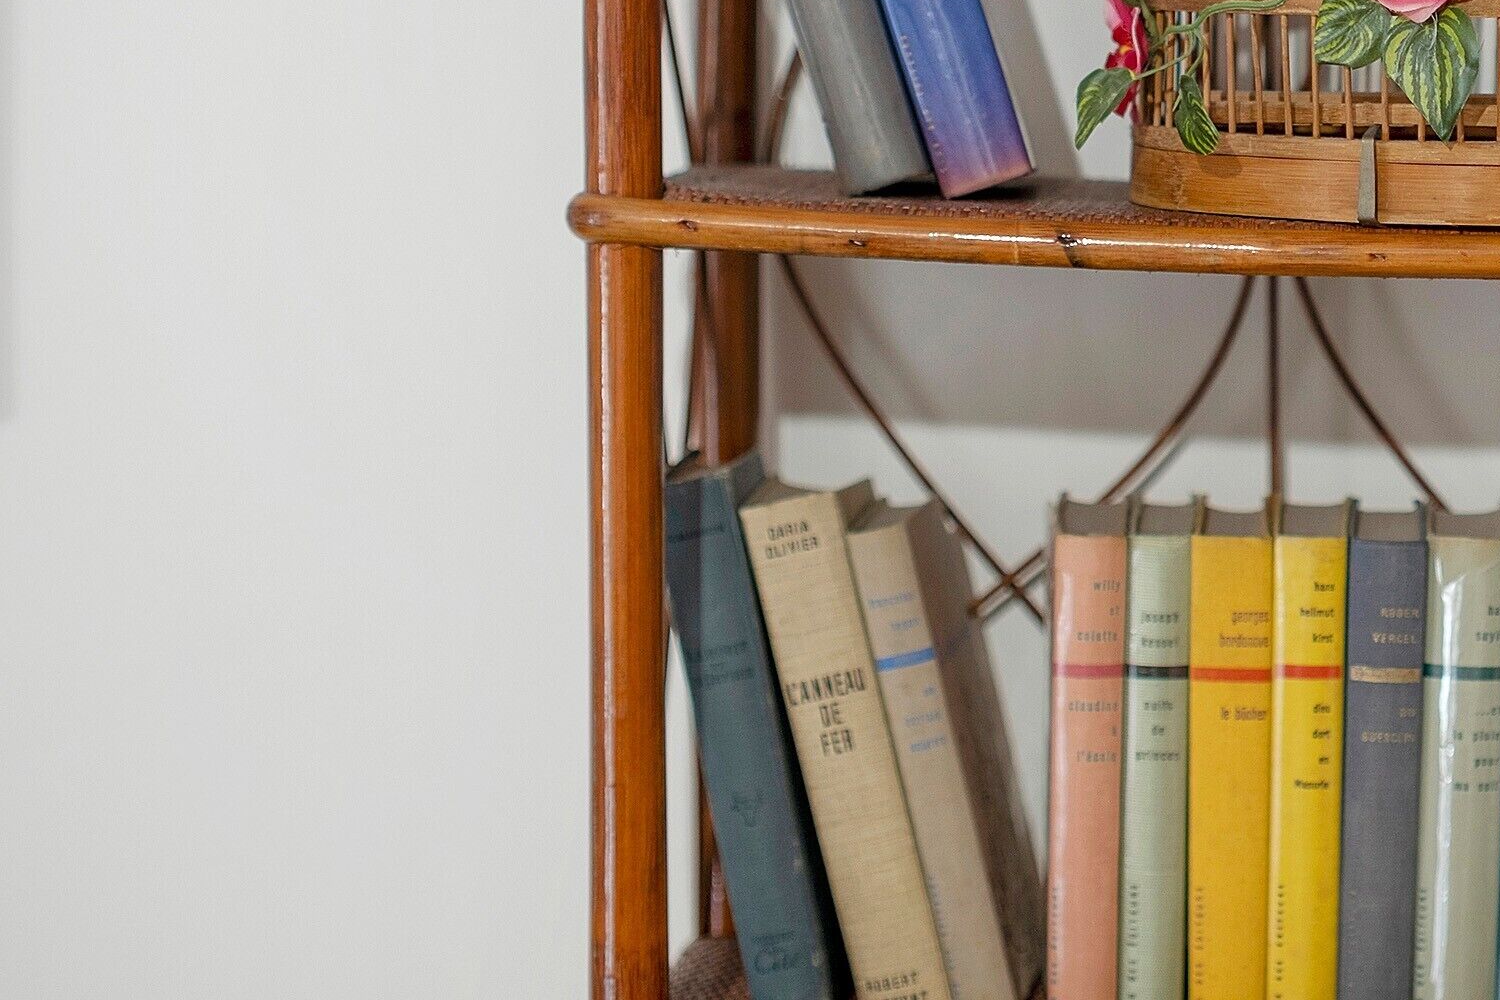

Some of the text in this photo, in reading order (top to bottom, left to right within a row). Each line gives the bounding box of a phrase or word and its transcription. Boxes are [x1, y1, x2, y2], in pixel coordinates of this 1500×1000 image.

[767, 520, 809, 541] DARIA
[765, 537, 818, 560] OLIVIER
[1093, 580, 1120, 593] willy
[1314, 581, 1335, 592] hans
[1300, 607, 1335, 618] hellmut
[785, 667, 866, 707] L'ANNEAU
[819, 702, 844, 728] DE
[820, 729, 853, 756] FER
[864, 971, 917, 992] ROBERT
